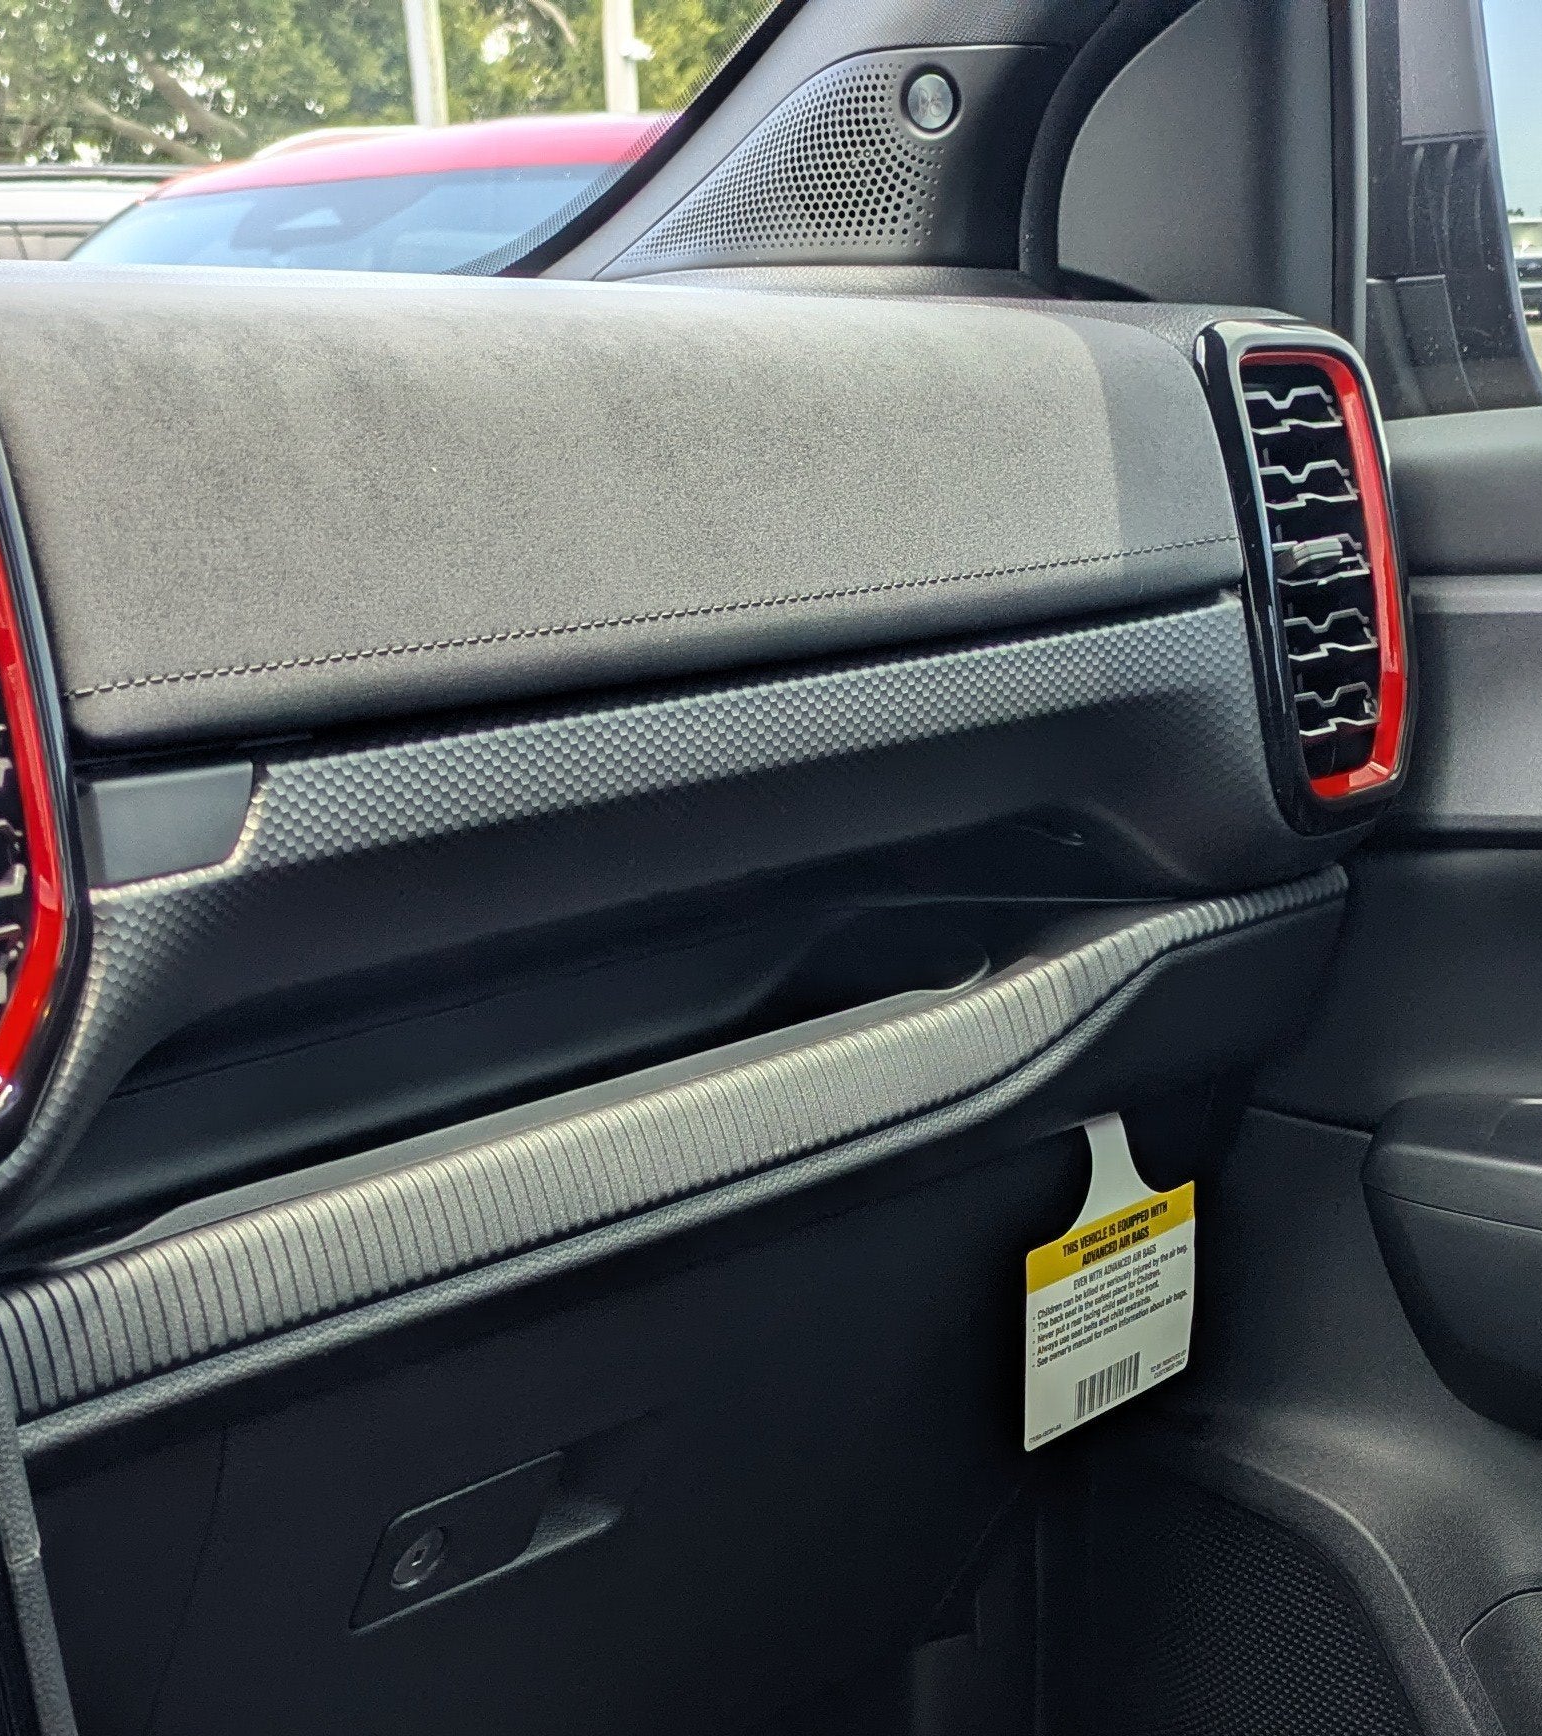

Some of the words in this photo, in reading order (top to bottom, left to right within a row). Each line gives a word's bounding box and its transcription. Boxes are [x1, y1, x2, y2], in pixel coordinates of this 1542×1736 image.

[1062, 1239, 1079, 1257] THIS
[1109, 1222, 1116, 1237] IS
[1119, 1234, 1131, 1250] AIR
